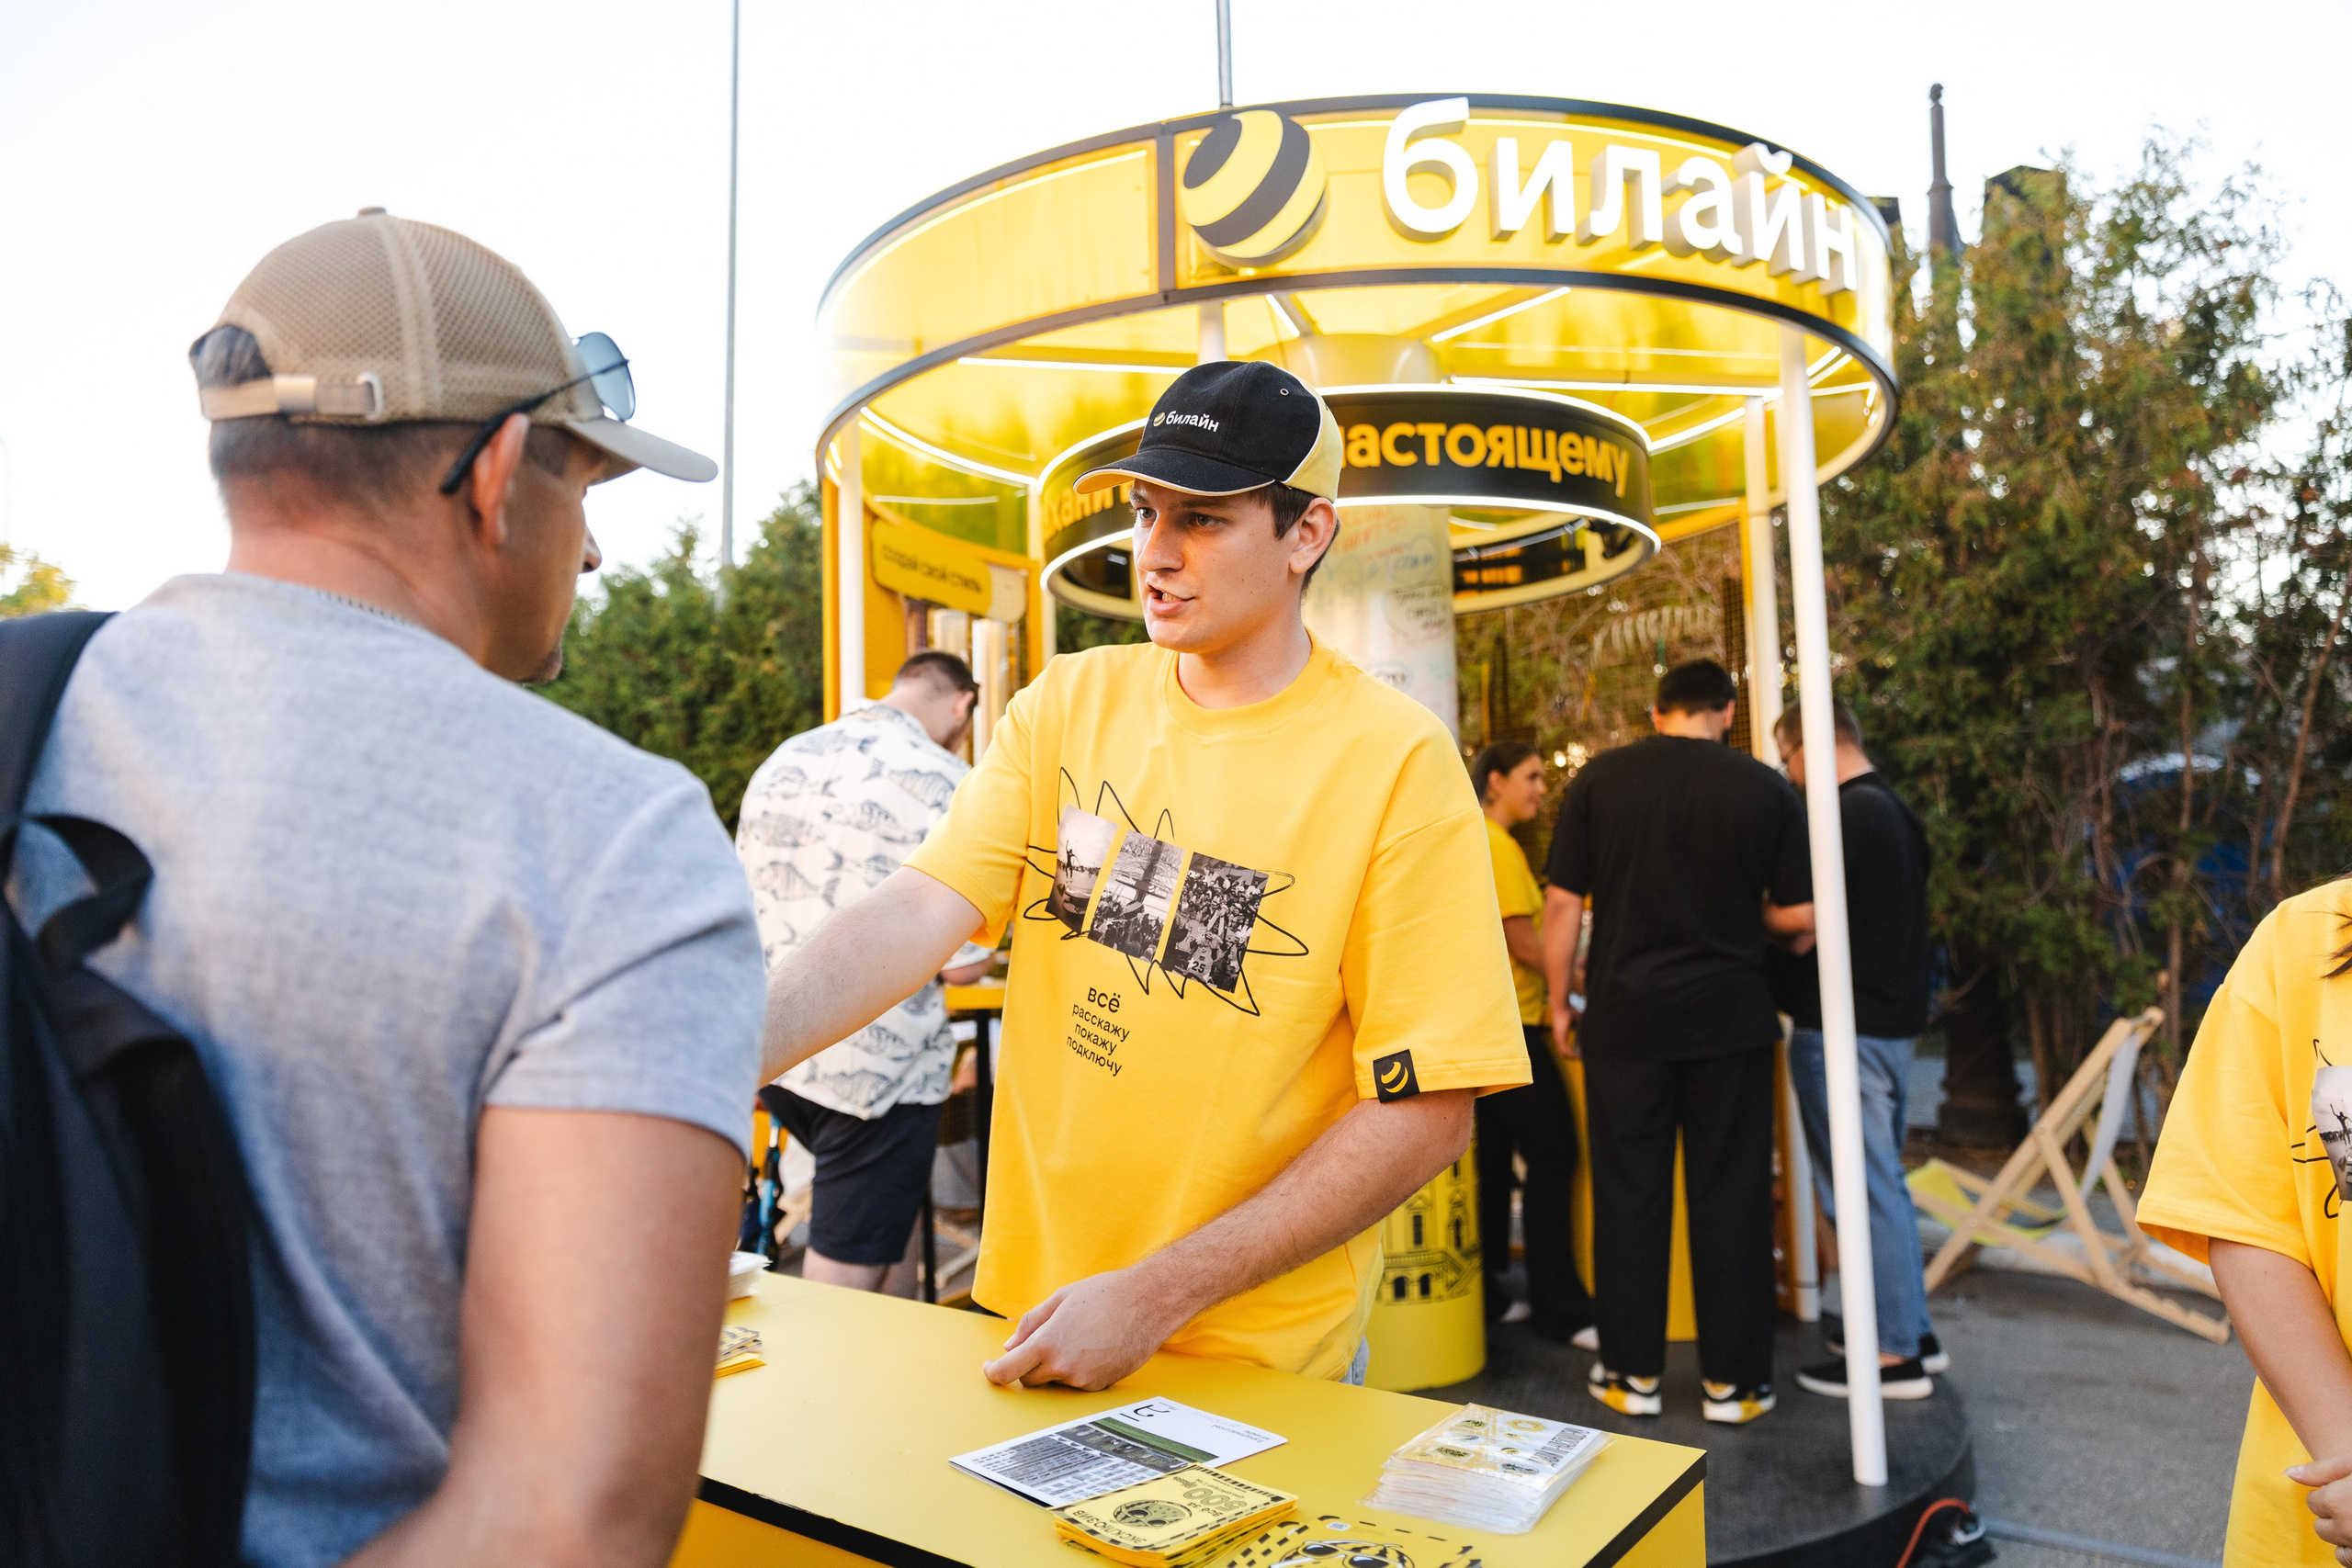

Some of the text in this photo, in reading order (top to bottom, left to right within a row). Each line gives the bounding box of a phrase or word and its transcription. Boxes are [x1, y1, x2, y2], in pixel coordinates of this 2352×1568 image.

[1382, 96, 1857, 292] билайн
[1165, 410, 1220, 433] билайн
[1340, 421, 1629, 499] астоящему
[1191, 960, 1206, 974] 25
[1087, 987, 1121, 1013] всё
[1071, 1004, 1130, 1043] расскажу
[1074, 1023, 1117, 1056] покажу
[1066, 1035, 1123, 1077] подключу
[1182, 1487, 1248, 1512] 500
[1072, 1509, 1148, 1544] ЭКСКЛЮЗИВ
